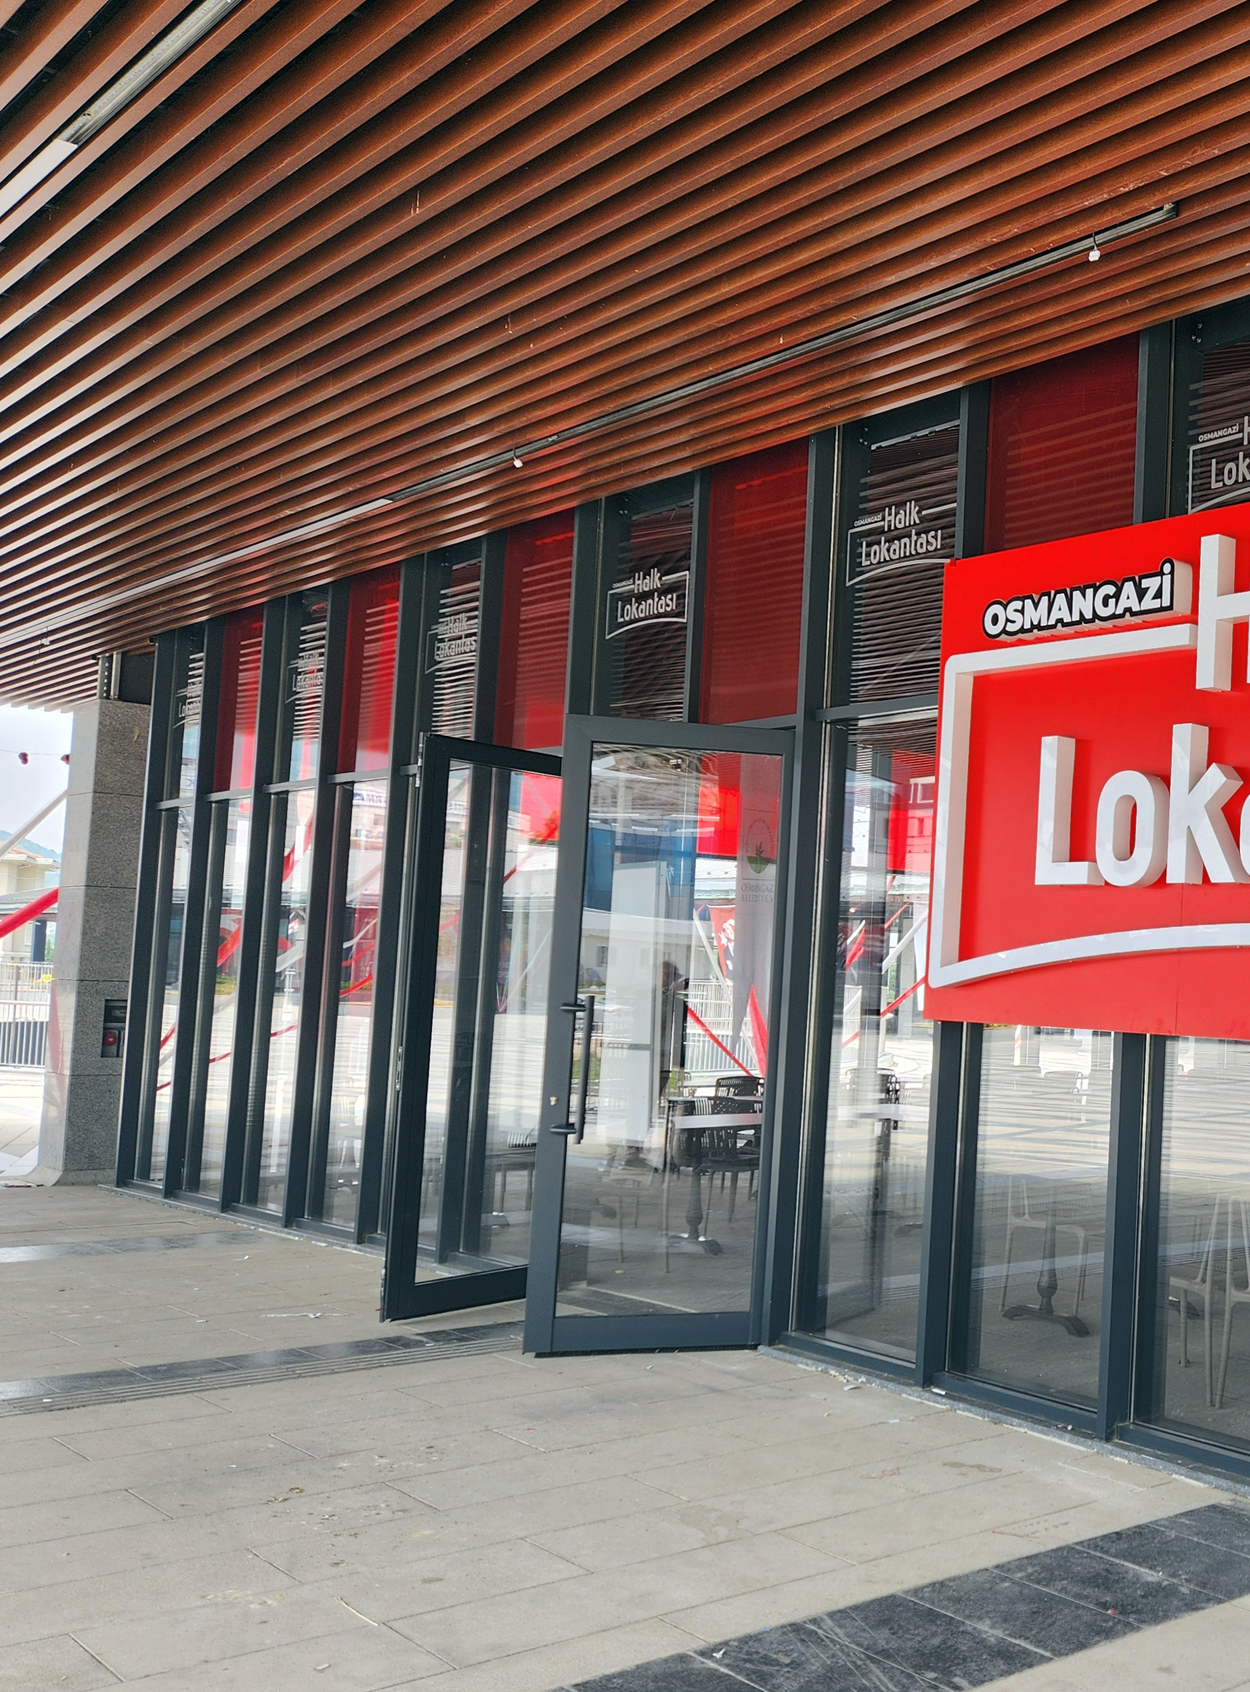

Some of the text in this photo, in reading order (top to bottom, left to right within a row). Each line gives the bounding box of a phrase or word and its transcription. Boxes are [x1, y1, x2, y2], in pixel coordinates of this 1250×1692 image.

[1198, 423, 1239, 442] OSMANGAZİ
[884, 500, 920, 532] Halk
[861, 528, 942, 567] Lokantası
[634, 567, 661, 594] Halk
[617, 592, 677, 622] Lokantası
[982, 557, 1175, 638] OSMANGAZİ
